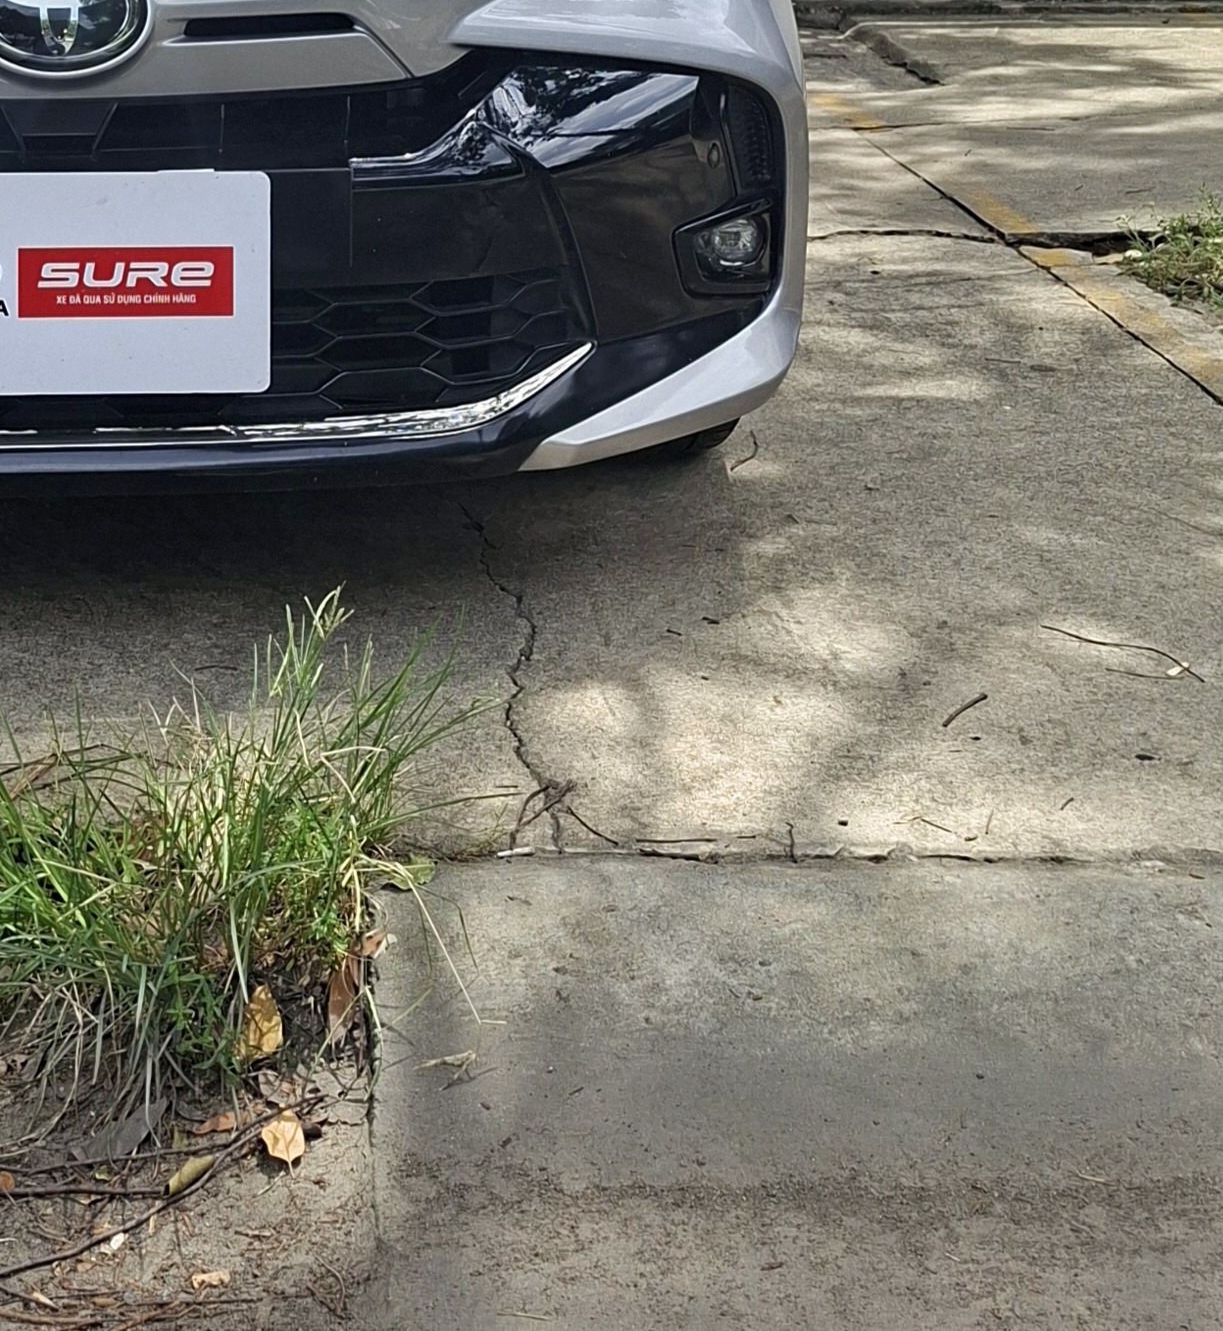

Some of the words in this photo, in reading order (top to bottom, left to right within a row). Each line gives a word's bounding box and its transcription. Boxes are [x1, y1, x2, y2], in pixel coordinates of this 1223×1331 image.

[56, 295, 67, 304] XE
[83, 295, 101, 304] QUA
[117, 294, 142, 306] DỤNG
[143, 292, 170, 304] CHÍNH
